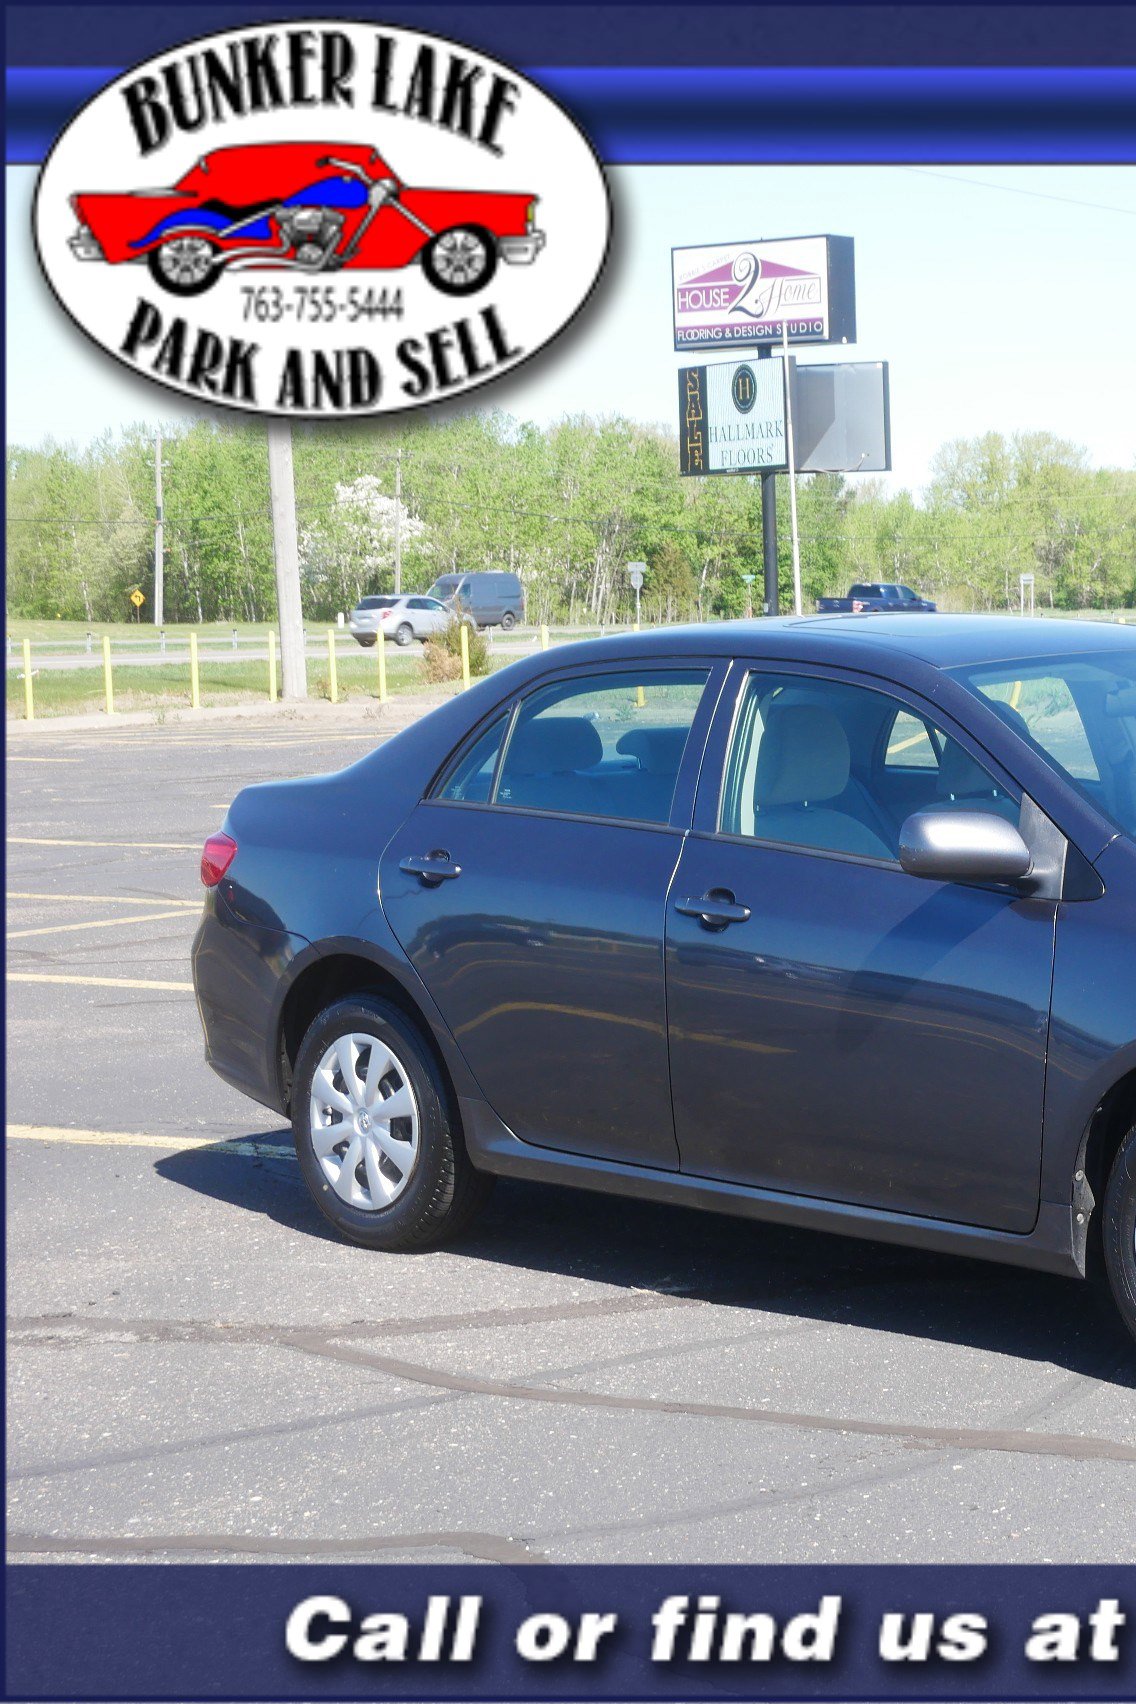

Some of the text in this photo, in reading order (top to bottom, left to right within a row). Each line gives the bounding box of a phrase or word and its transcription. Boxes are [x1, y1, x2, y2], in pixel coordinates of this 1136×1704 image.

[678, 252, 816, 318] HOUSE 2 Home
[677, 321, 823, 342] FLOORING & DESIGN SUDIO
[709, 420, 784, 443] HALLMARK
